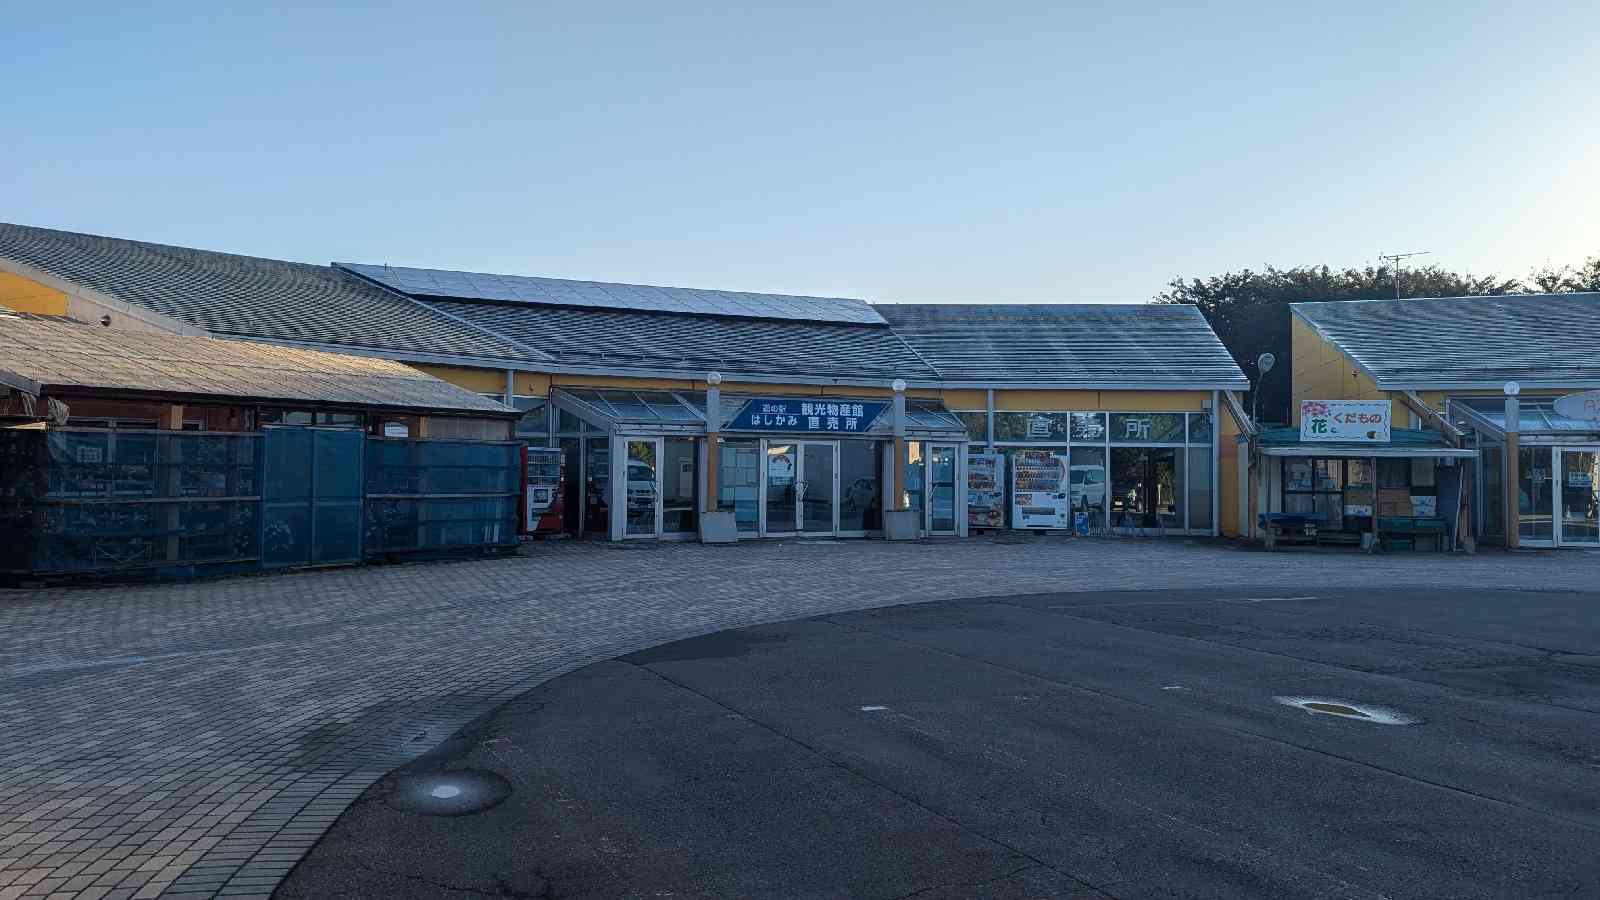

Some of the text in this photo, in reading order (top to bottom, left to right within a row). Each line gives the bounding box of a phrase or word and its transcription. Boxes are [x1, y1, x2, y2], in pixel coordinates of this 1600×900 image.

[801, 403, 864, 418] 観光物産館
[752, 415, 798, 426] はしかみ
[808, 417, 858, 430] 直売所
[1334, 412, 1382, 424] くだもの
